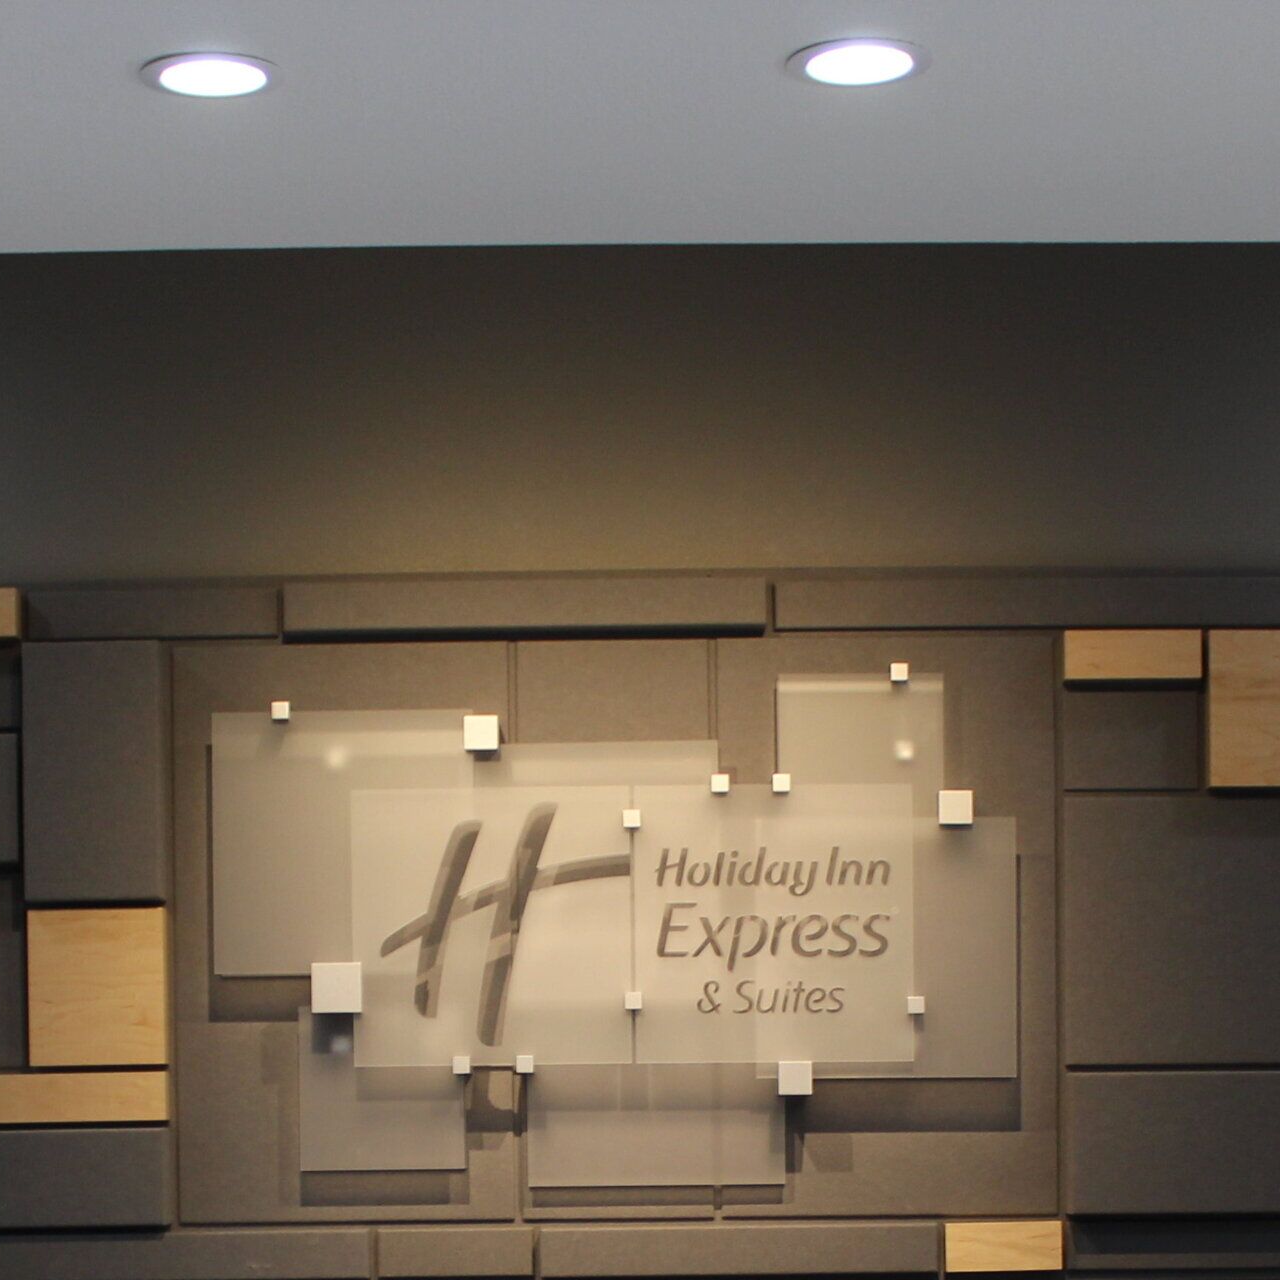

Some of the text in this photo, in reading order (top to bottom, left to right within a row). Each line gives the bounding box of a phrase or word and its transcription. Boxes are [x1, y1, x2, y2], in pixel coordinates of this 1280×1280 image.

[655, 846, 891, 896] Holiday Inn
[656, 902, 891, 972] Express
[696, 980, 845, 1014] & Suites
